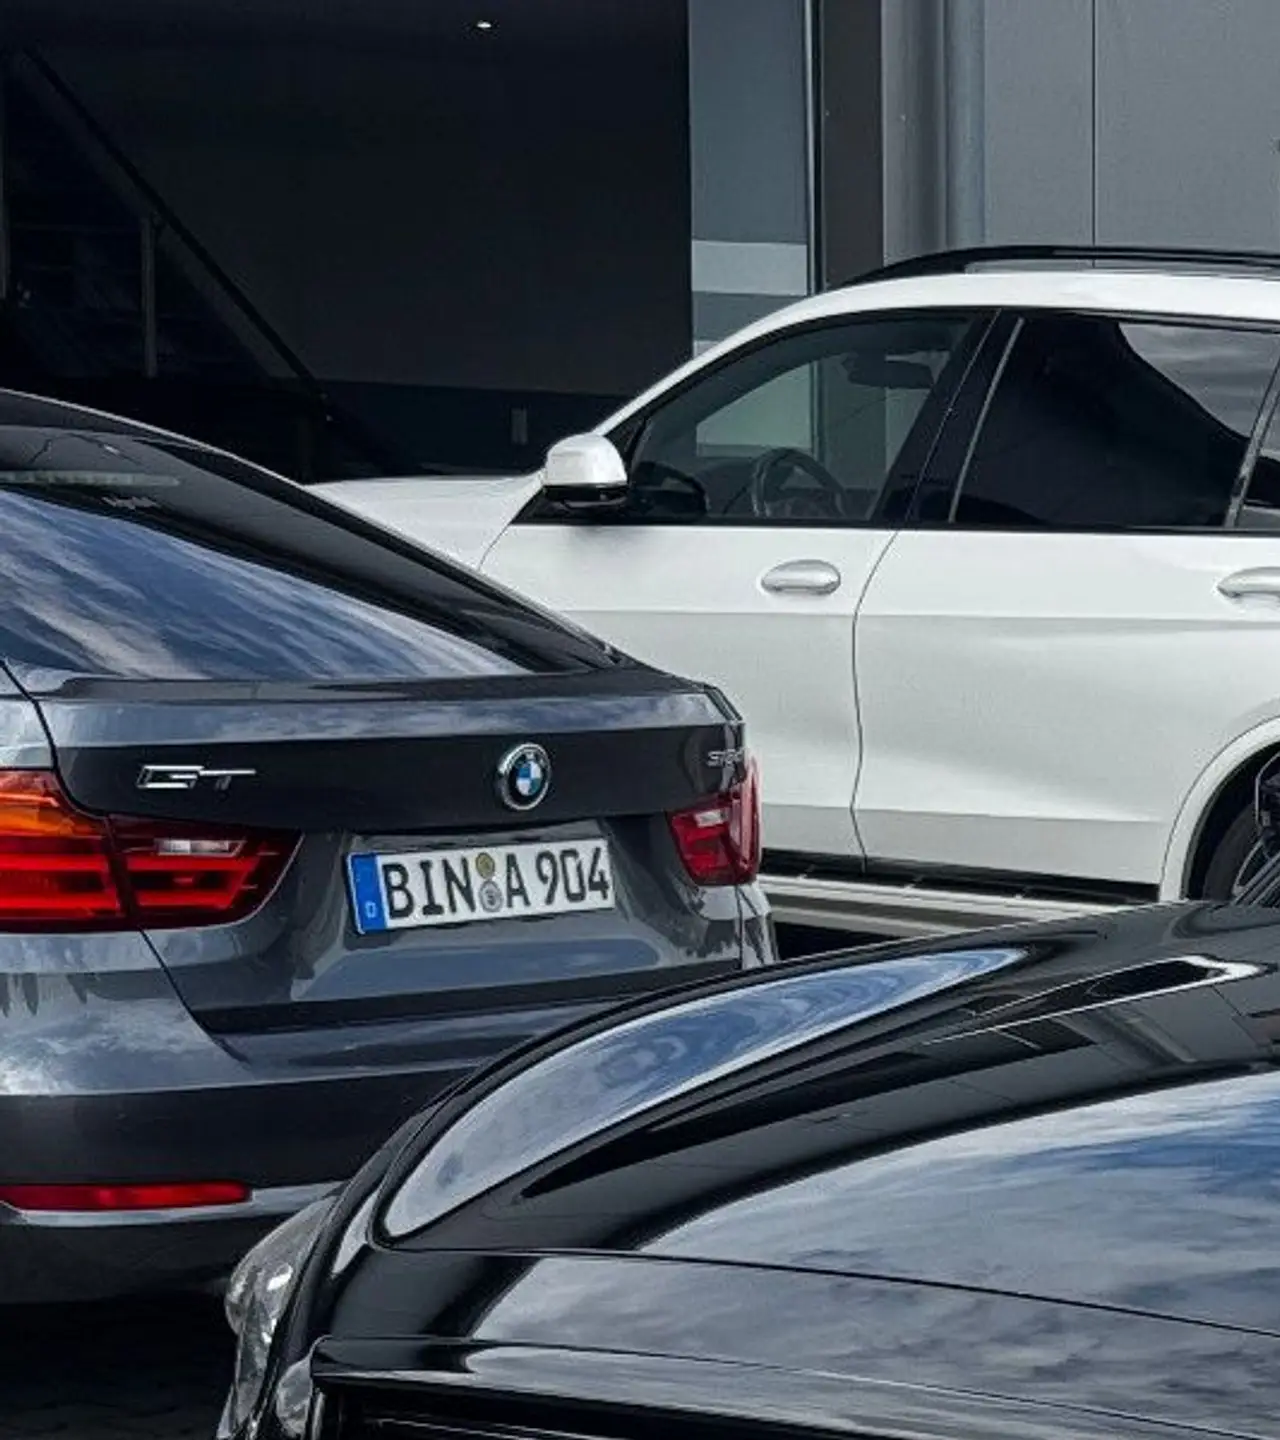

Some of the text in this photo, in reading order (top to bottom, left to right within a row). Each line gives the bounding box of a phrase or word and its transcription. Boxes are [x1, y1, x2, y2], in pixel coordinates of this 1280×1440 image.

[137, 764, 256, 790] GT
[382, 852, 475, 919] BIN
[505, 853, 531, 908] A
[536, 847, 609, 905] 904
